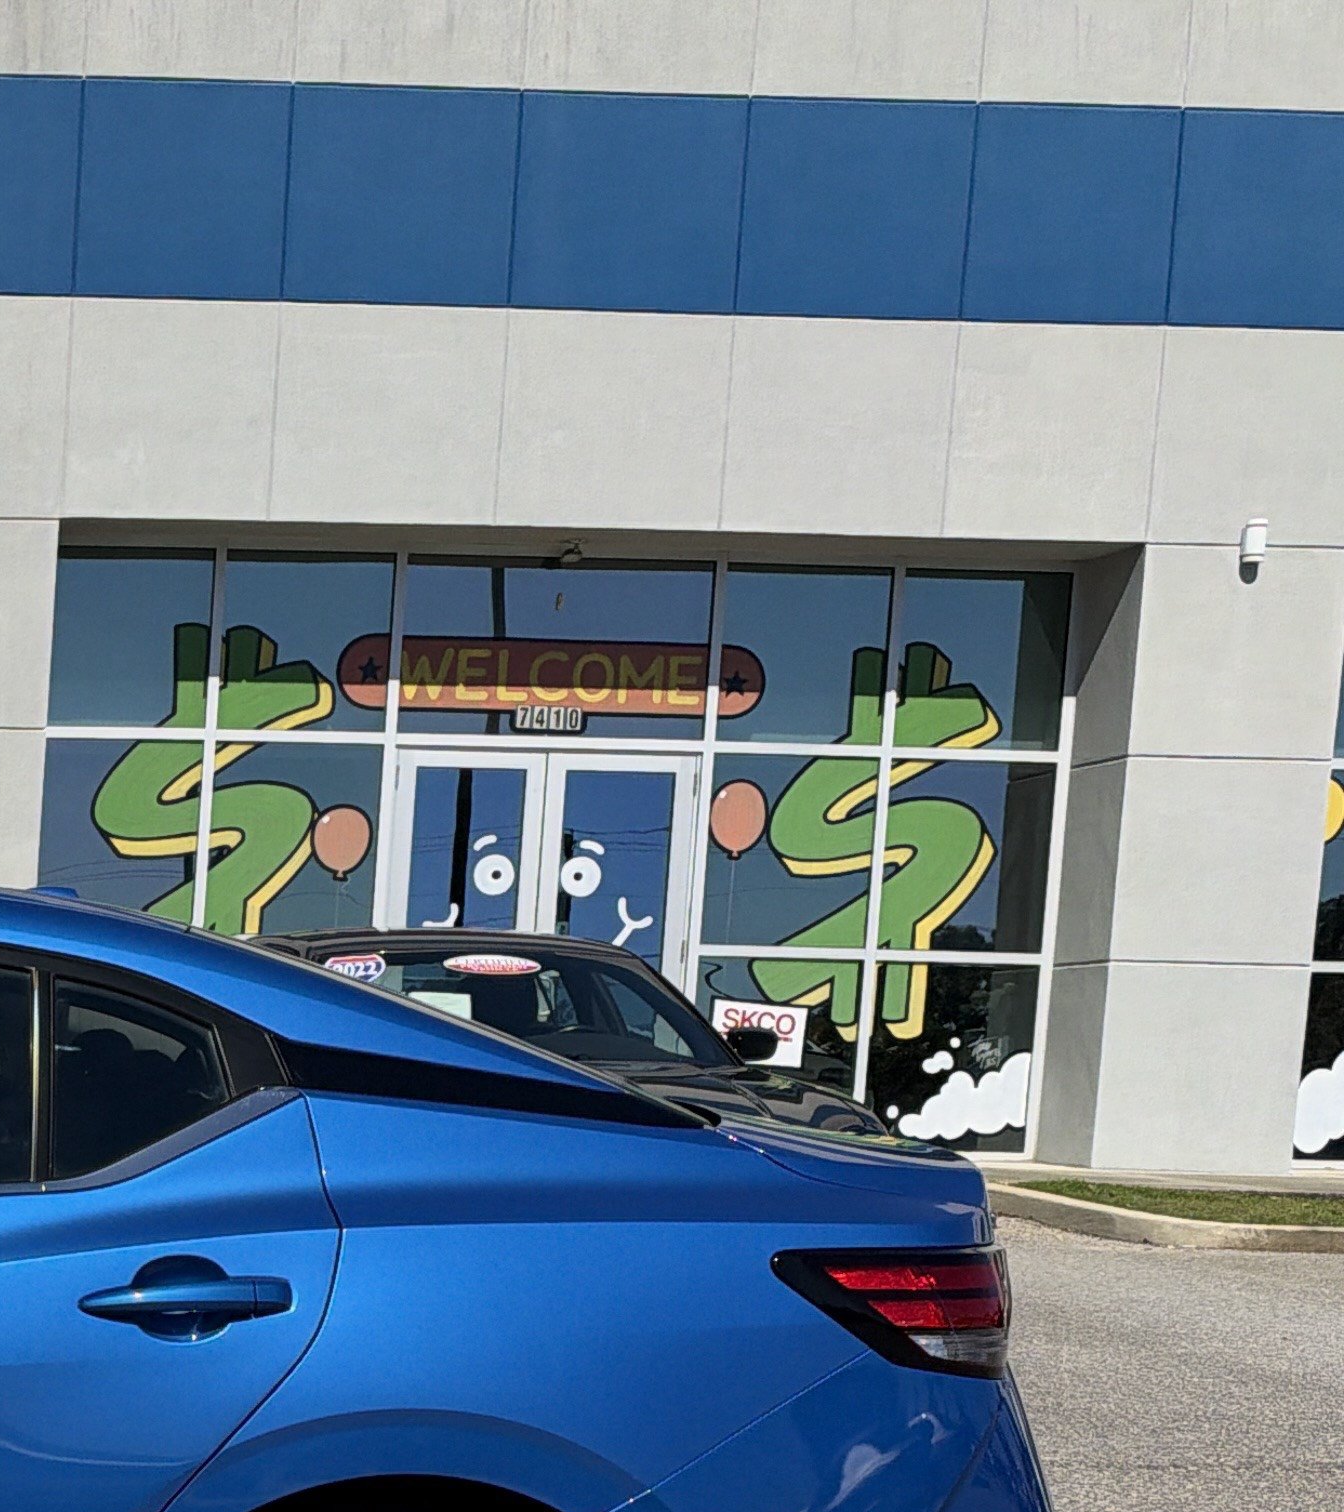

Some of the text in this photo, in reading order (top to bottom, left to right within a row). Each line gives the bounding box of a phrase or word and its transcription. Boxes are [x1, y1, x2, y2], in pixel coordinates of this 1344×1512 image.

[402, 648, 703, 705] WELCOME
[517, 706, 579, 730] 7410
[722, 1008, 796, 1035] SKCO
